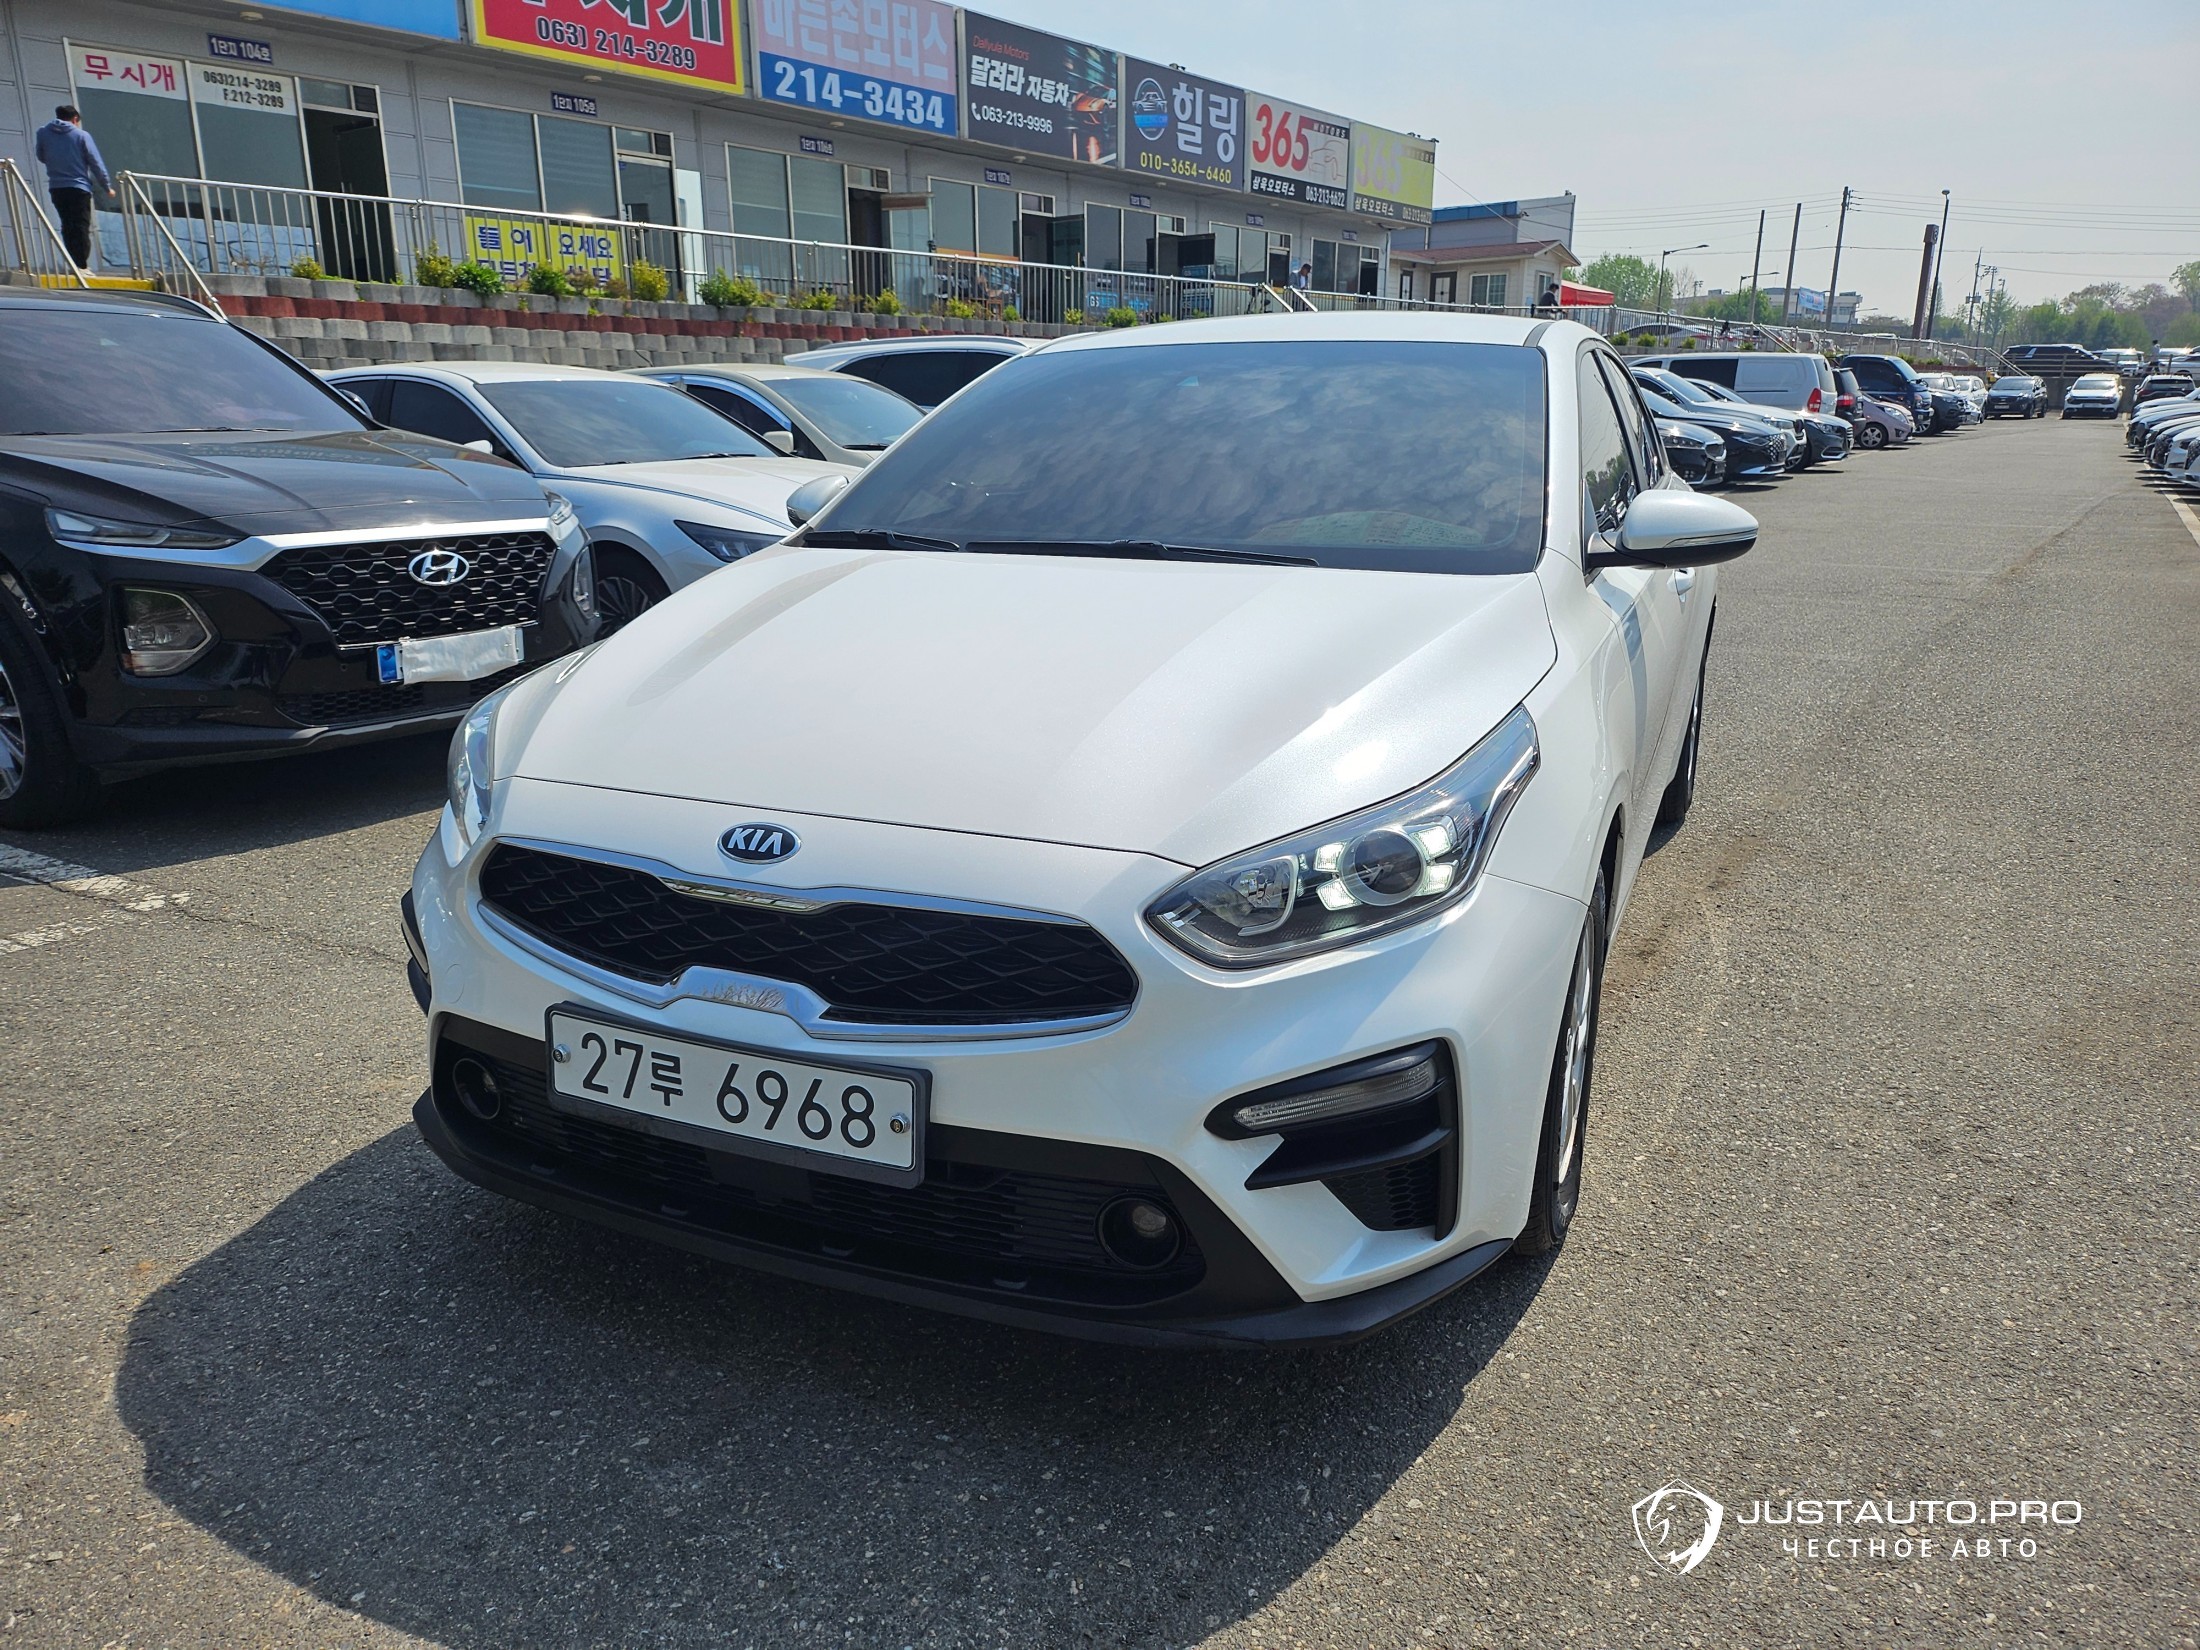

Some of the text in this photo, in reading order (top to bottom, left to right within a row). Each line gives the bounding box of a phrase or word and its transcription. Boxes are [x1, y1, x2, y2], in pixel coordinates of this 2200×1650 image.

[536, 16, 588, 49] 063)
[595, 30, 696, 70] 214-3289
[775, 60, 945, 129] 214-3434
[970, 55, 1070, 106] 달려라 자동차
[982, 105, 1053, 134] 063-213-9996
[1172, 82, 1239, 163] 힐링
[1253, 104, 1310, 172] 365
[1141, 152, 1232, 184] 010-3654-6460
[1305, 185, 1345, 207] 063-213-6622
[727, 828, 783, 855] KIA
[581, 1032, 876, 1148] 27루 6968
